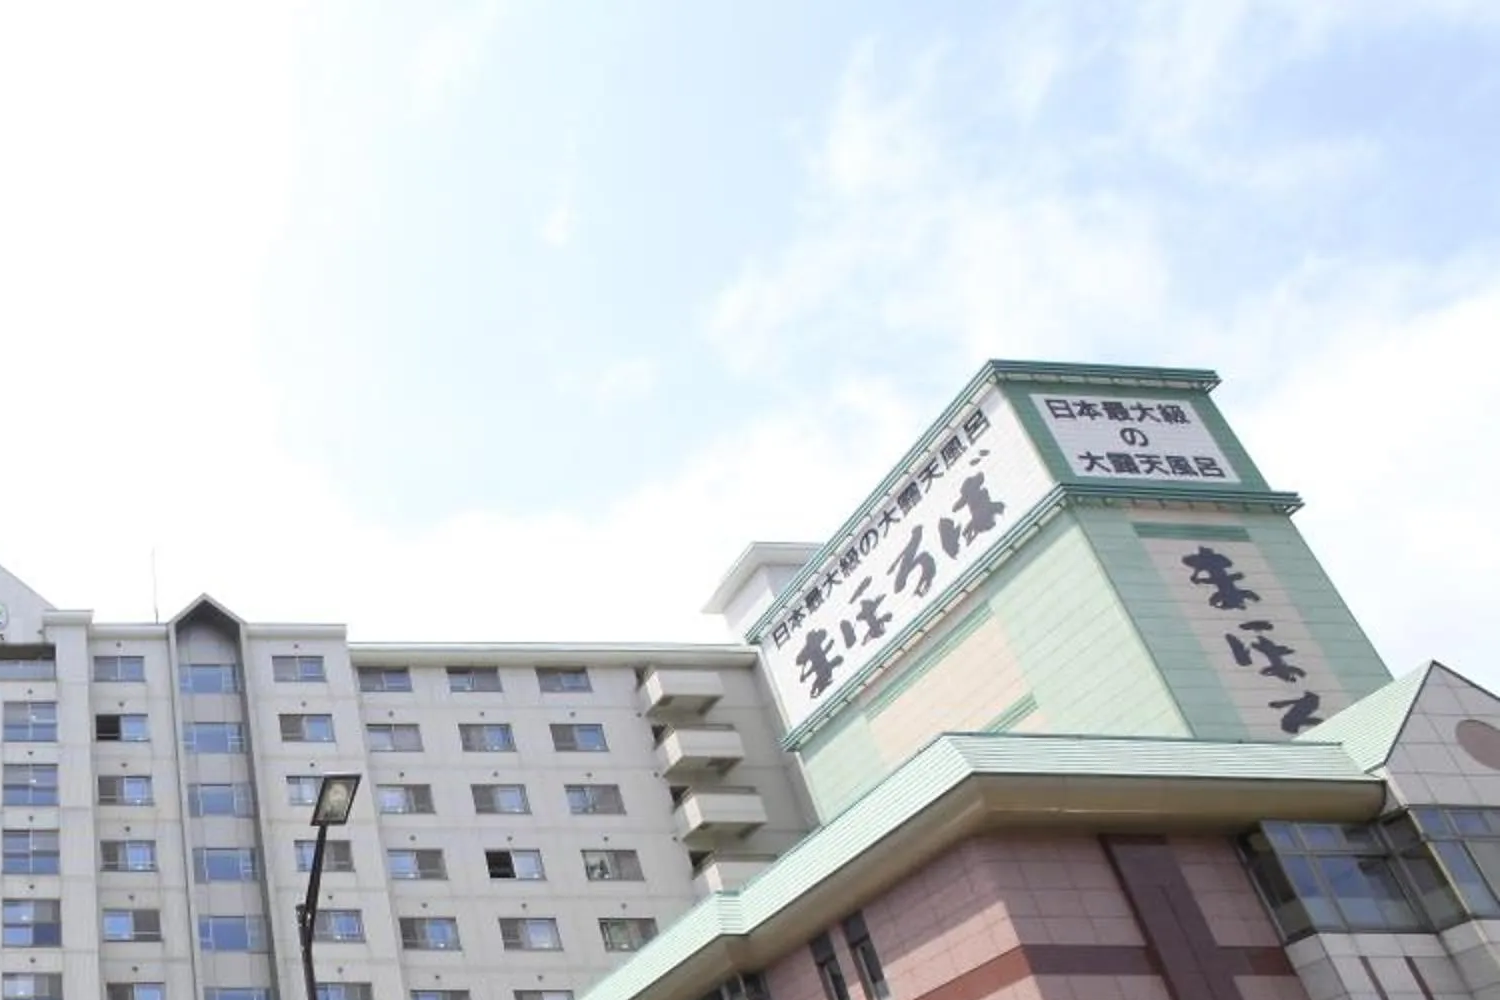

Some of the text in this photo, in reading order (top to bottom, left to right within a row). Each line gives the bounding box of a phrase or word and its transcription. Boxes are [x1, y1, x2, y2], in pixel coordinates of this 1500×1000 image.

[1120, 427, 1149, 447] の
[796, 449, 1005, 698] まほろば
